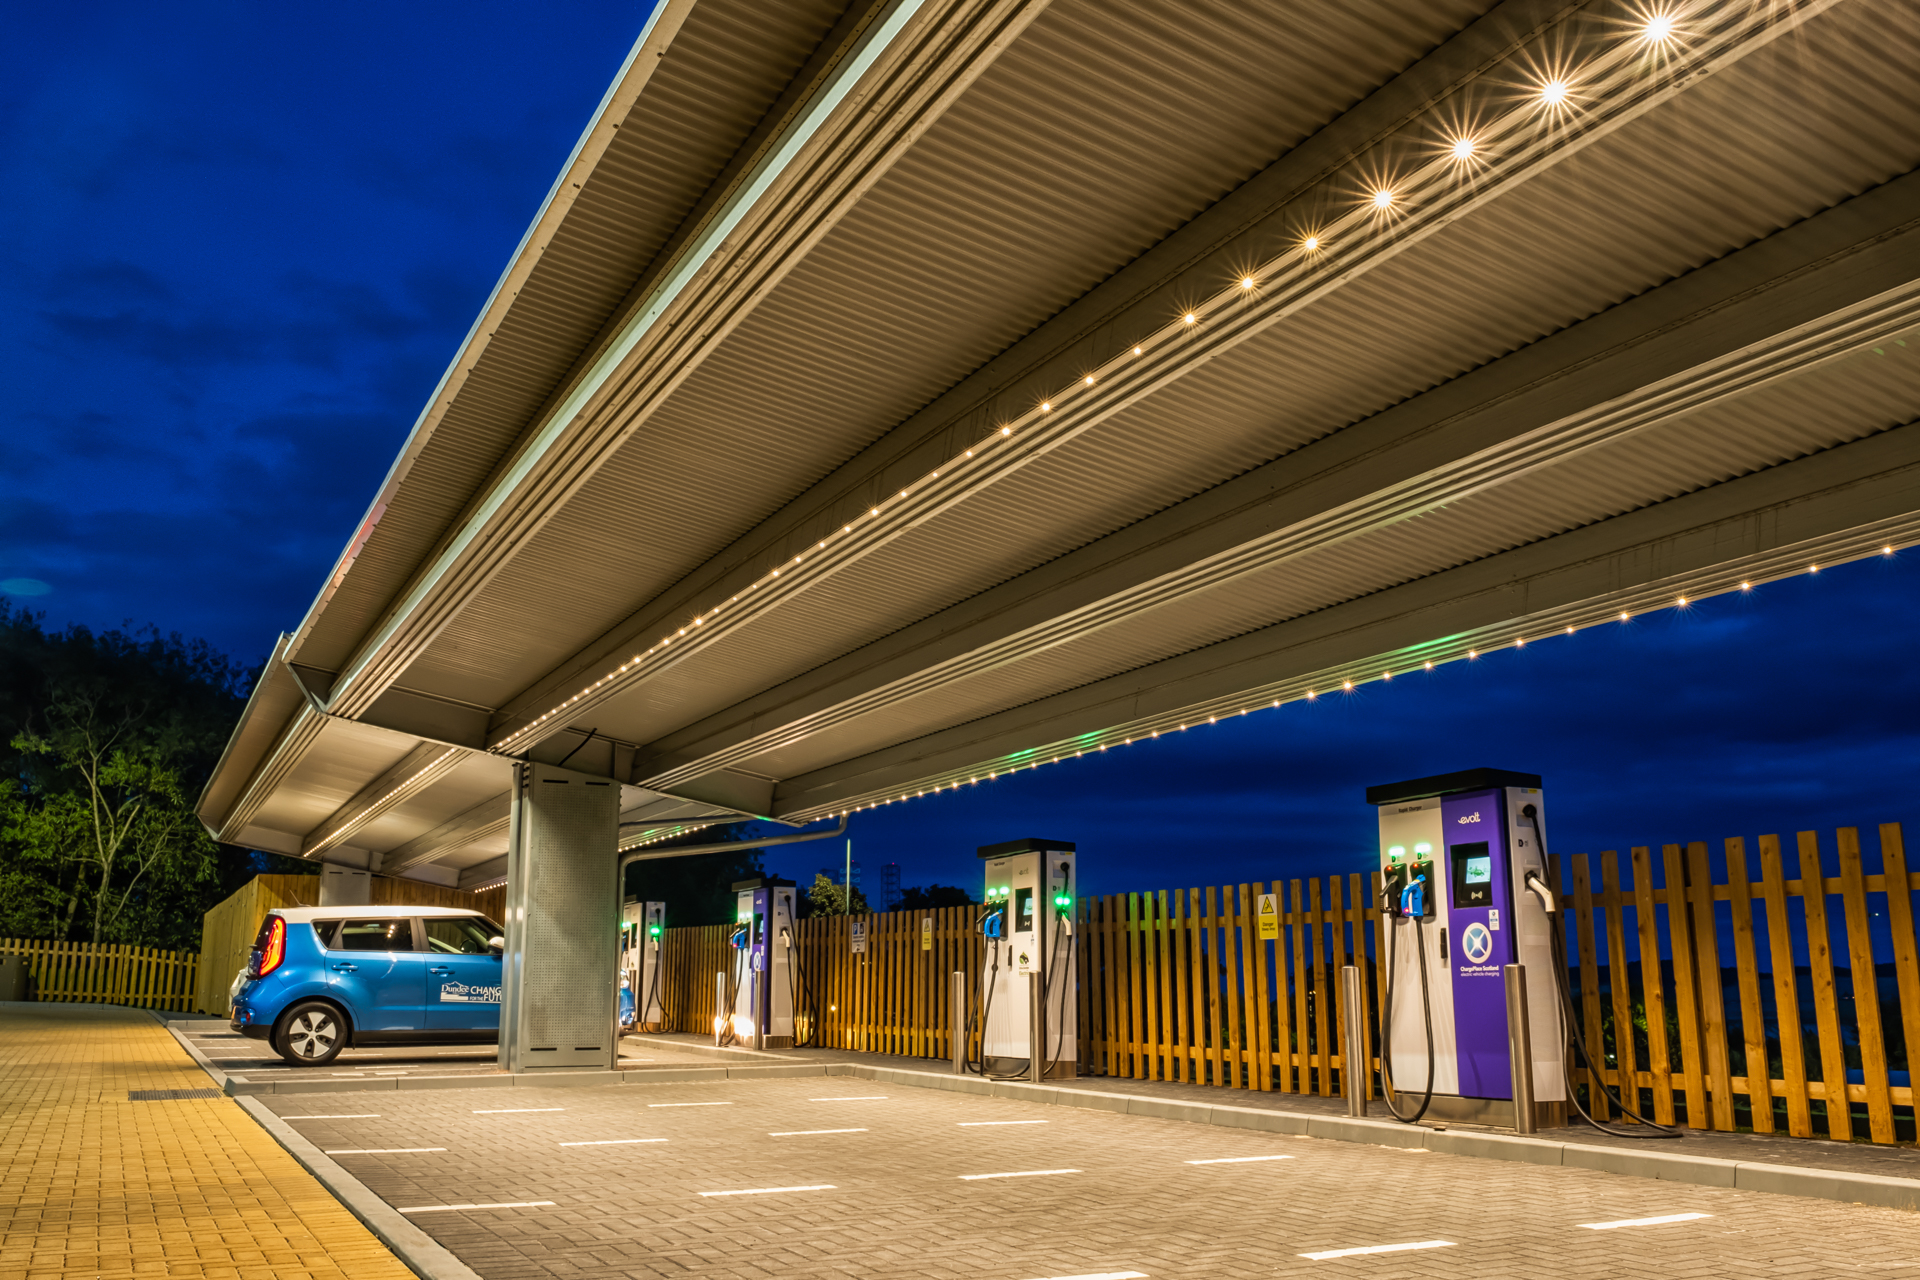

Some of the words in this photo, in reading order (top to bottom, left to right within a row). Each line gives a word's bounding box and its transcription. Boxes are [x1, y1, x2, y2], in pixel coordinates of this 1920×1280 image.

[1457, 811, 1481, 824] evolt
[441, 984, 469, 993] Dundee
[470, 986, 502, 995] CHANG
[483, 990, 502, 1002] FUT
